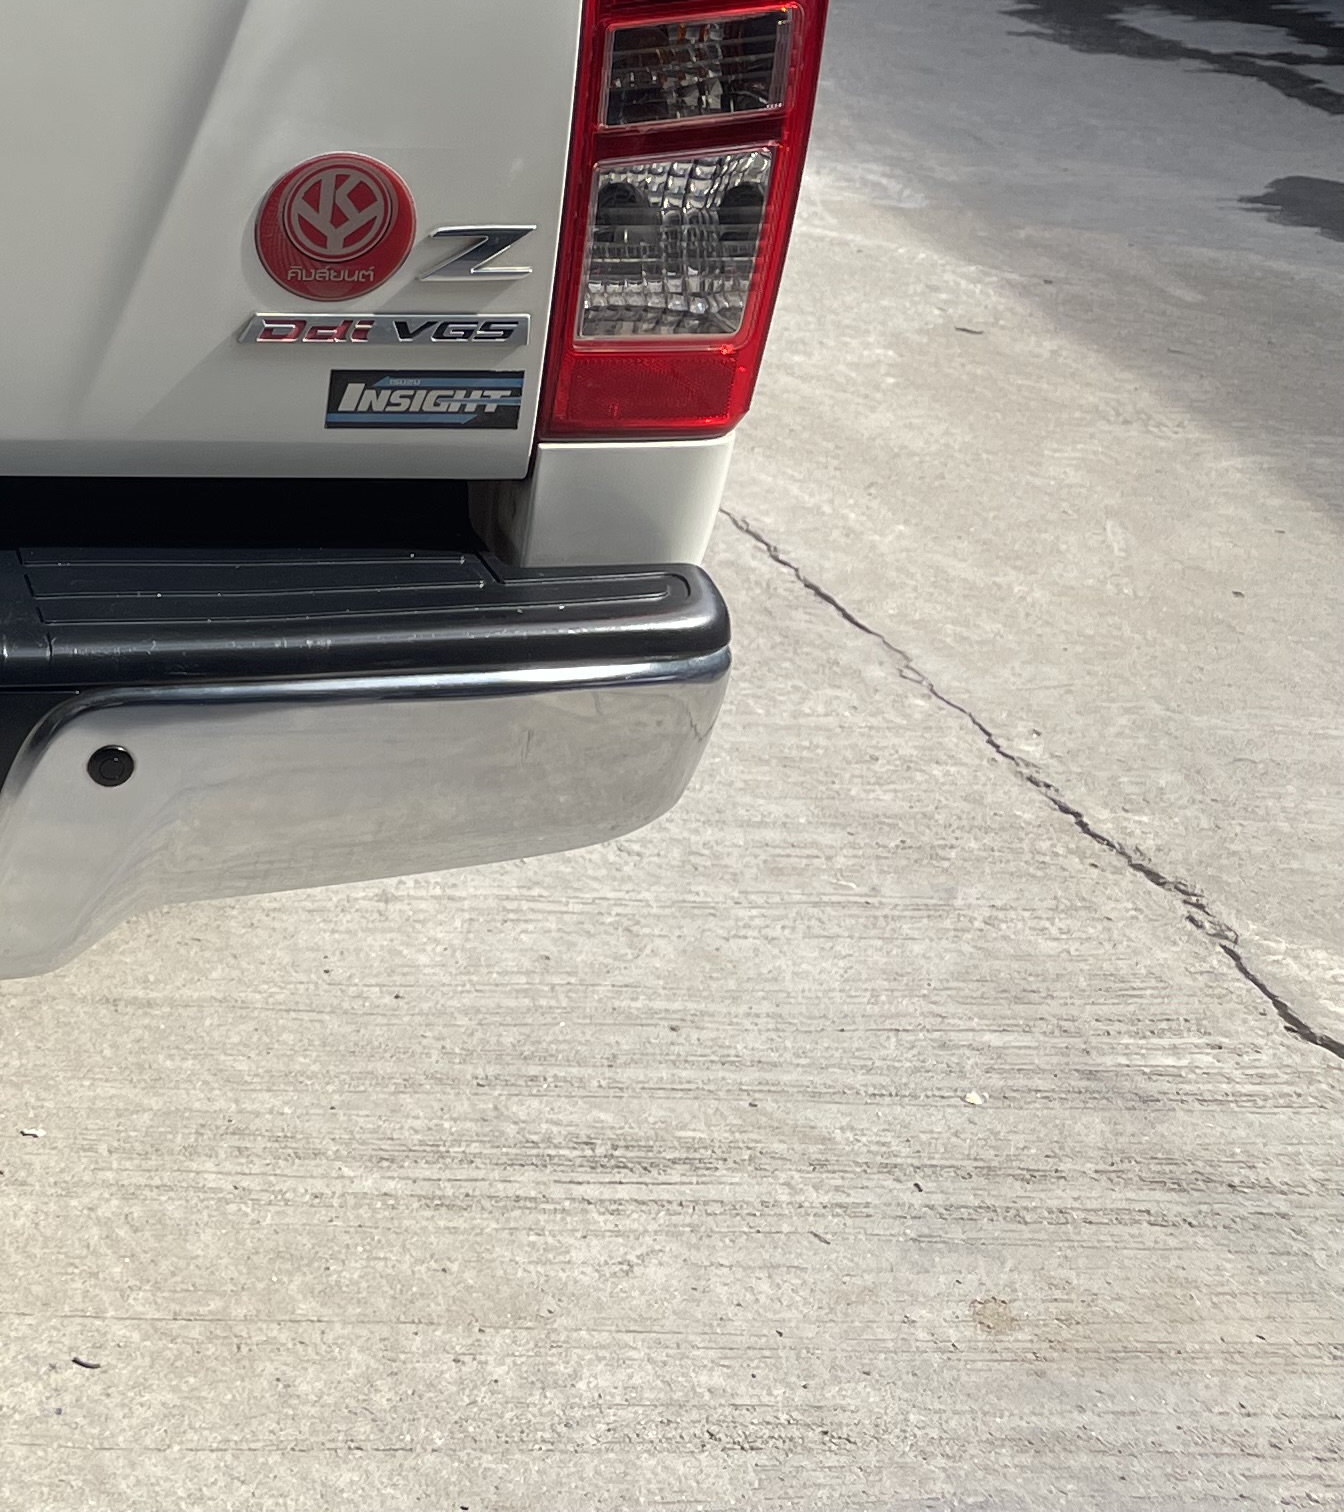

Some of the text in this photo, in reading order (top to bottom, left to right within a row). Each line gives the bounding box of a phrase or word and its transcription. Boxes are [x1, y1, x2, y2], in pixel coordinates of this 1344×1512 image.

[418, 225, 537, 281] Z
[256, 319, 519, 343] Ddi VGS
[337, 382, 513, 413] INSIGHT
